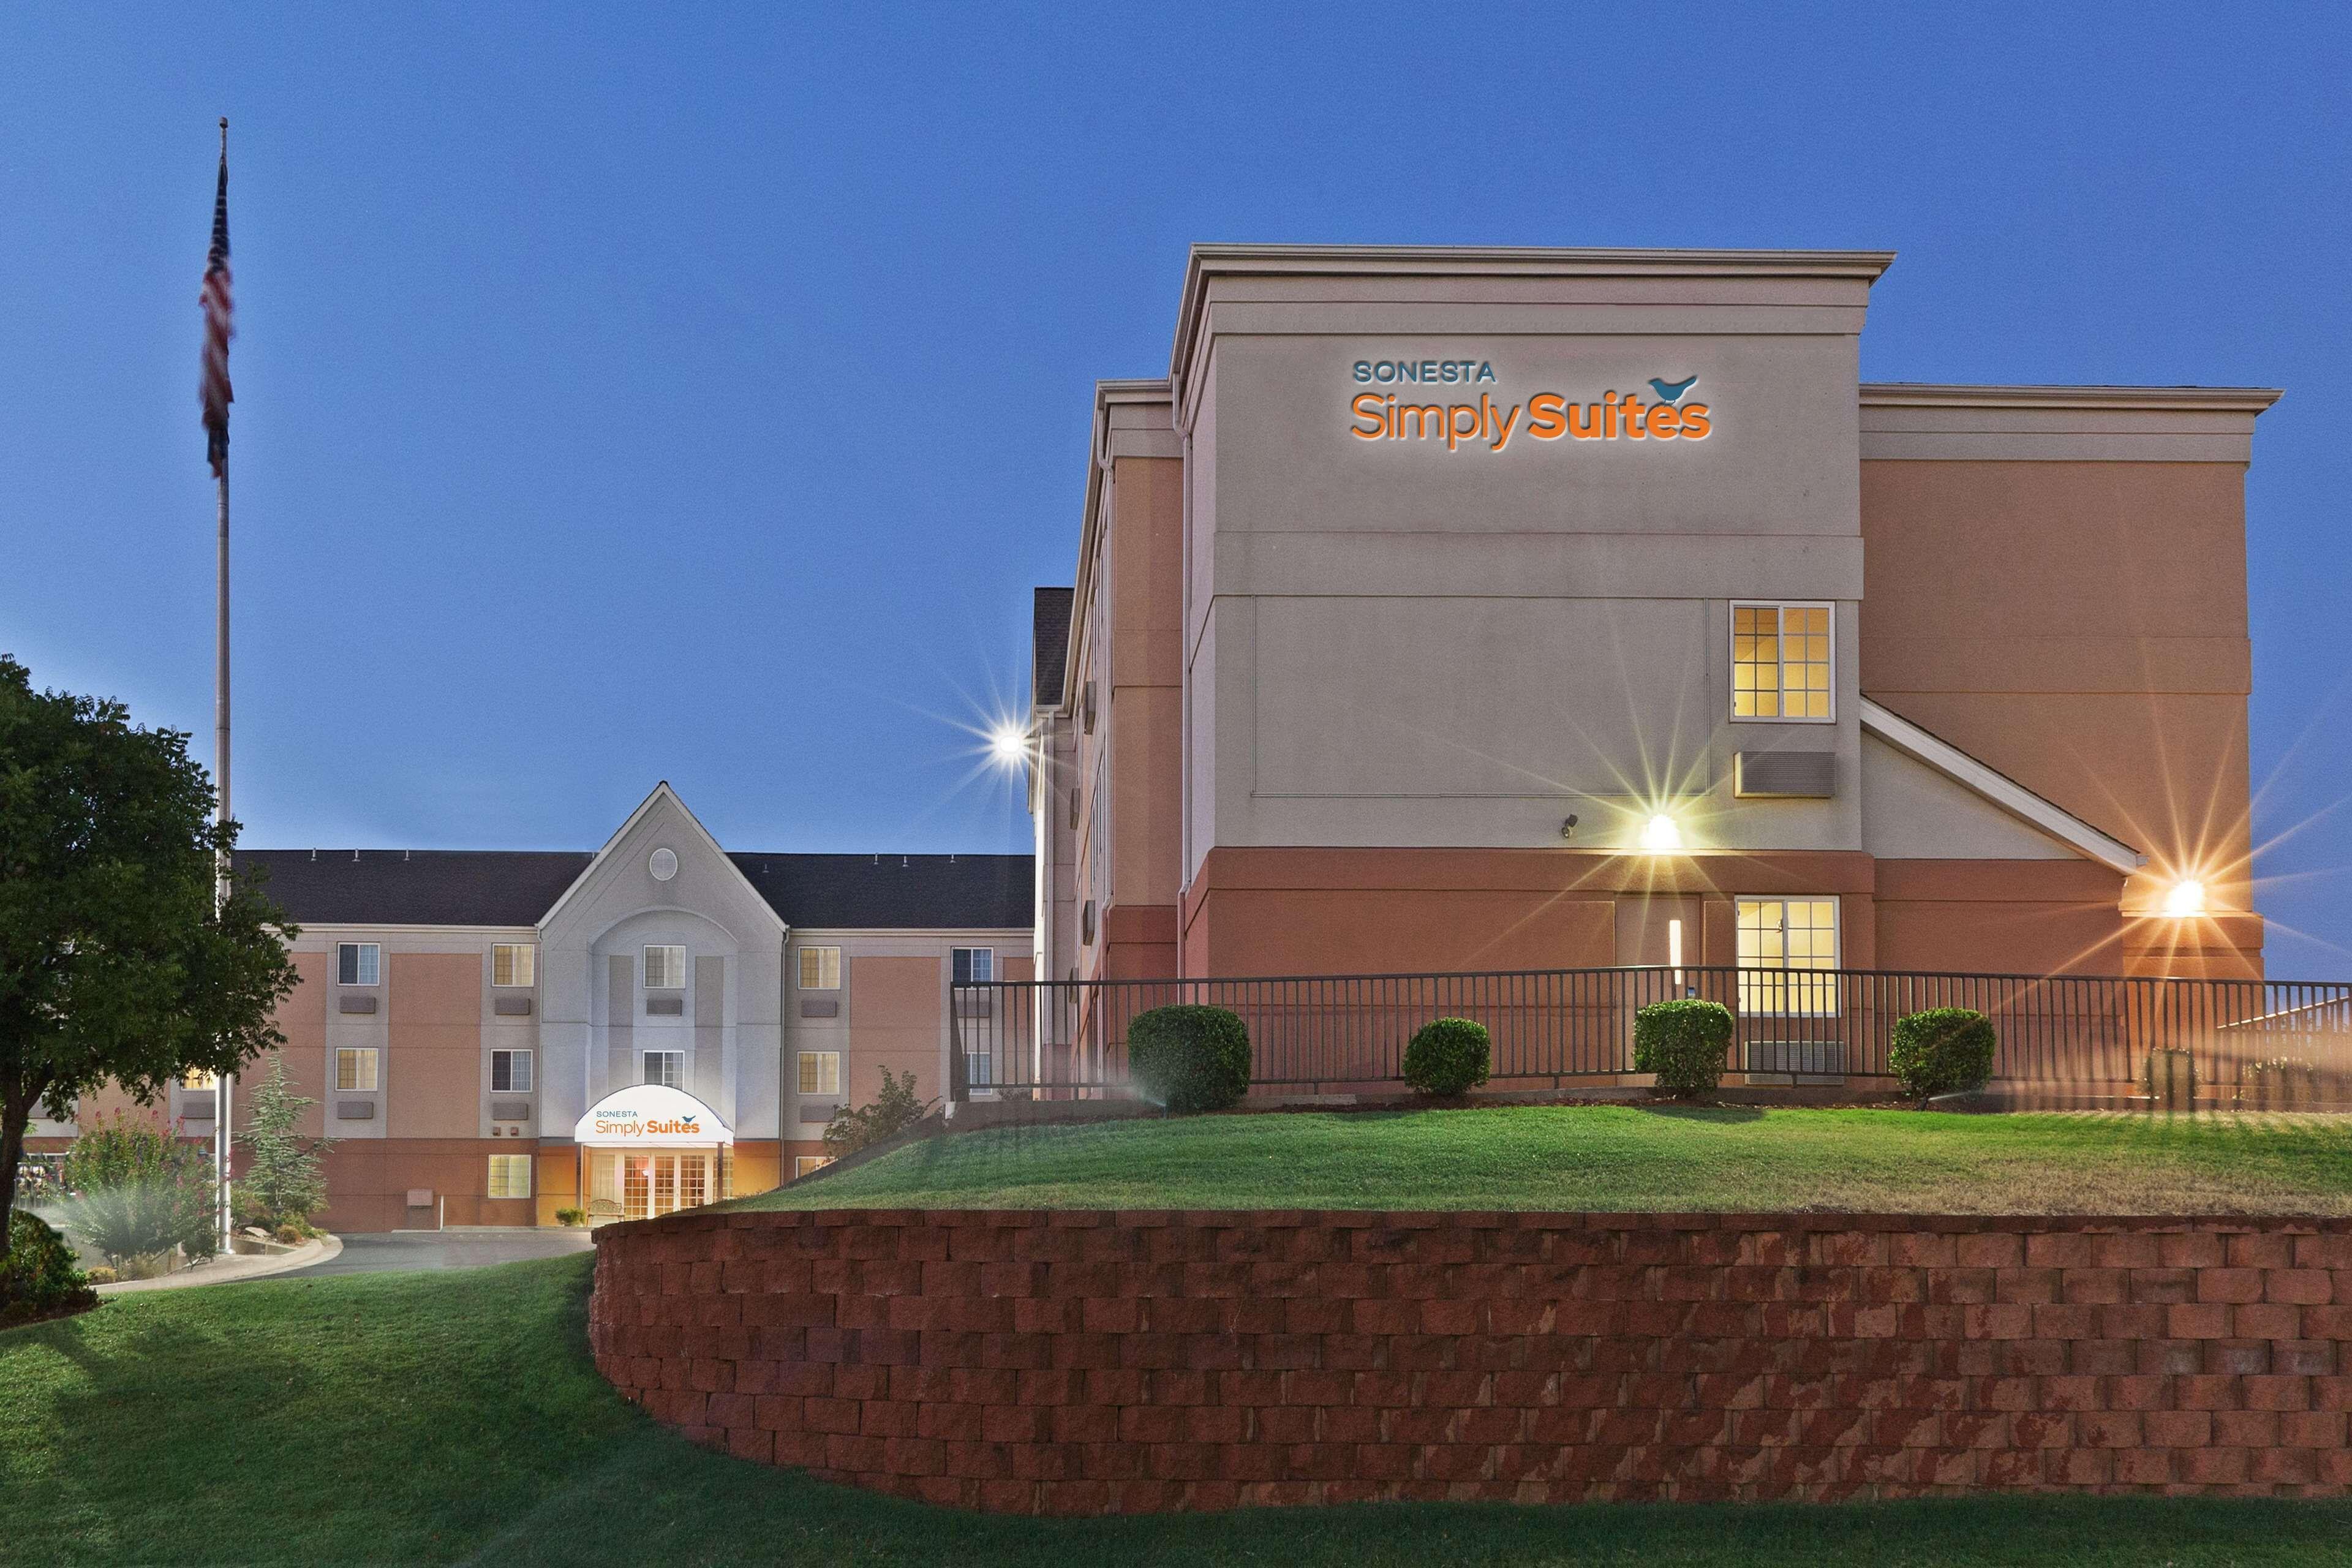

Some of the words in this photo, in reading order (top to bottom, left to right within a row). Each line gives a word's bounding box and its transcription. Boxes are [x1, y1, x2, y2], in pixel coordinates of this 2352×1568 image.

[1354, 361, 1495, 382] SONESTA
[1351, 394, 1520, 450] Simply
[1528, 392, 1710, 439] Suites
[596, 1120, 644, 1137] Simply
[647, 1120, 700, 1133] Suites
